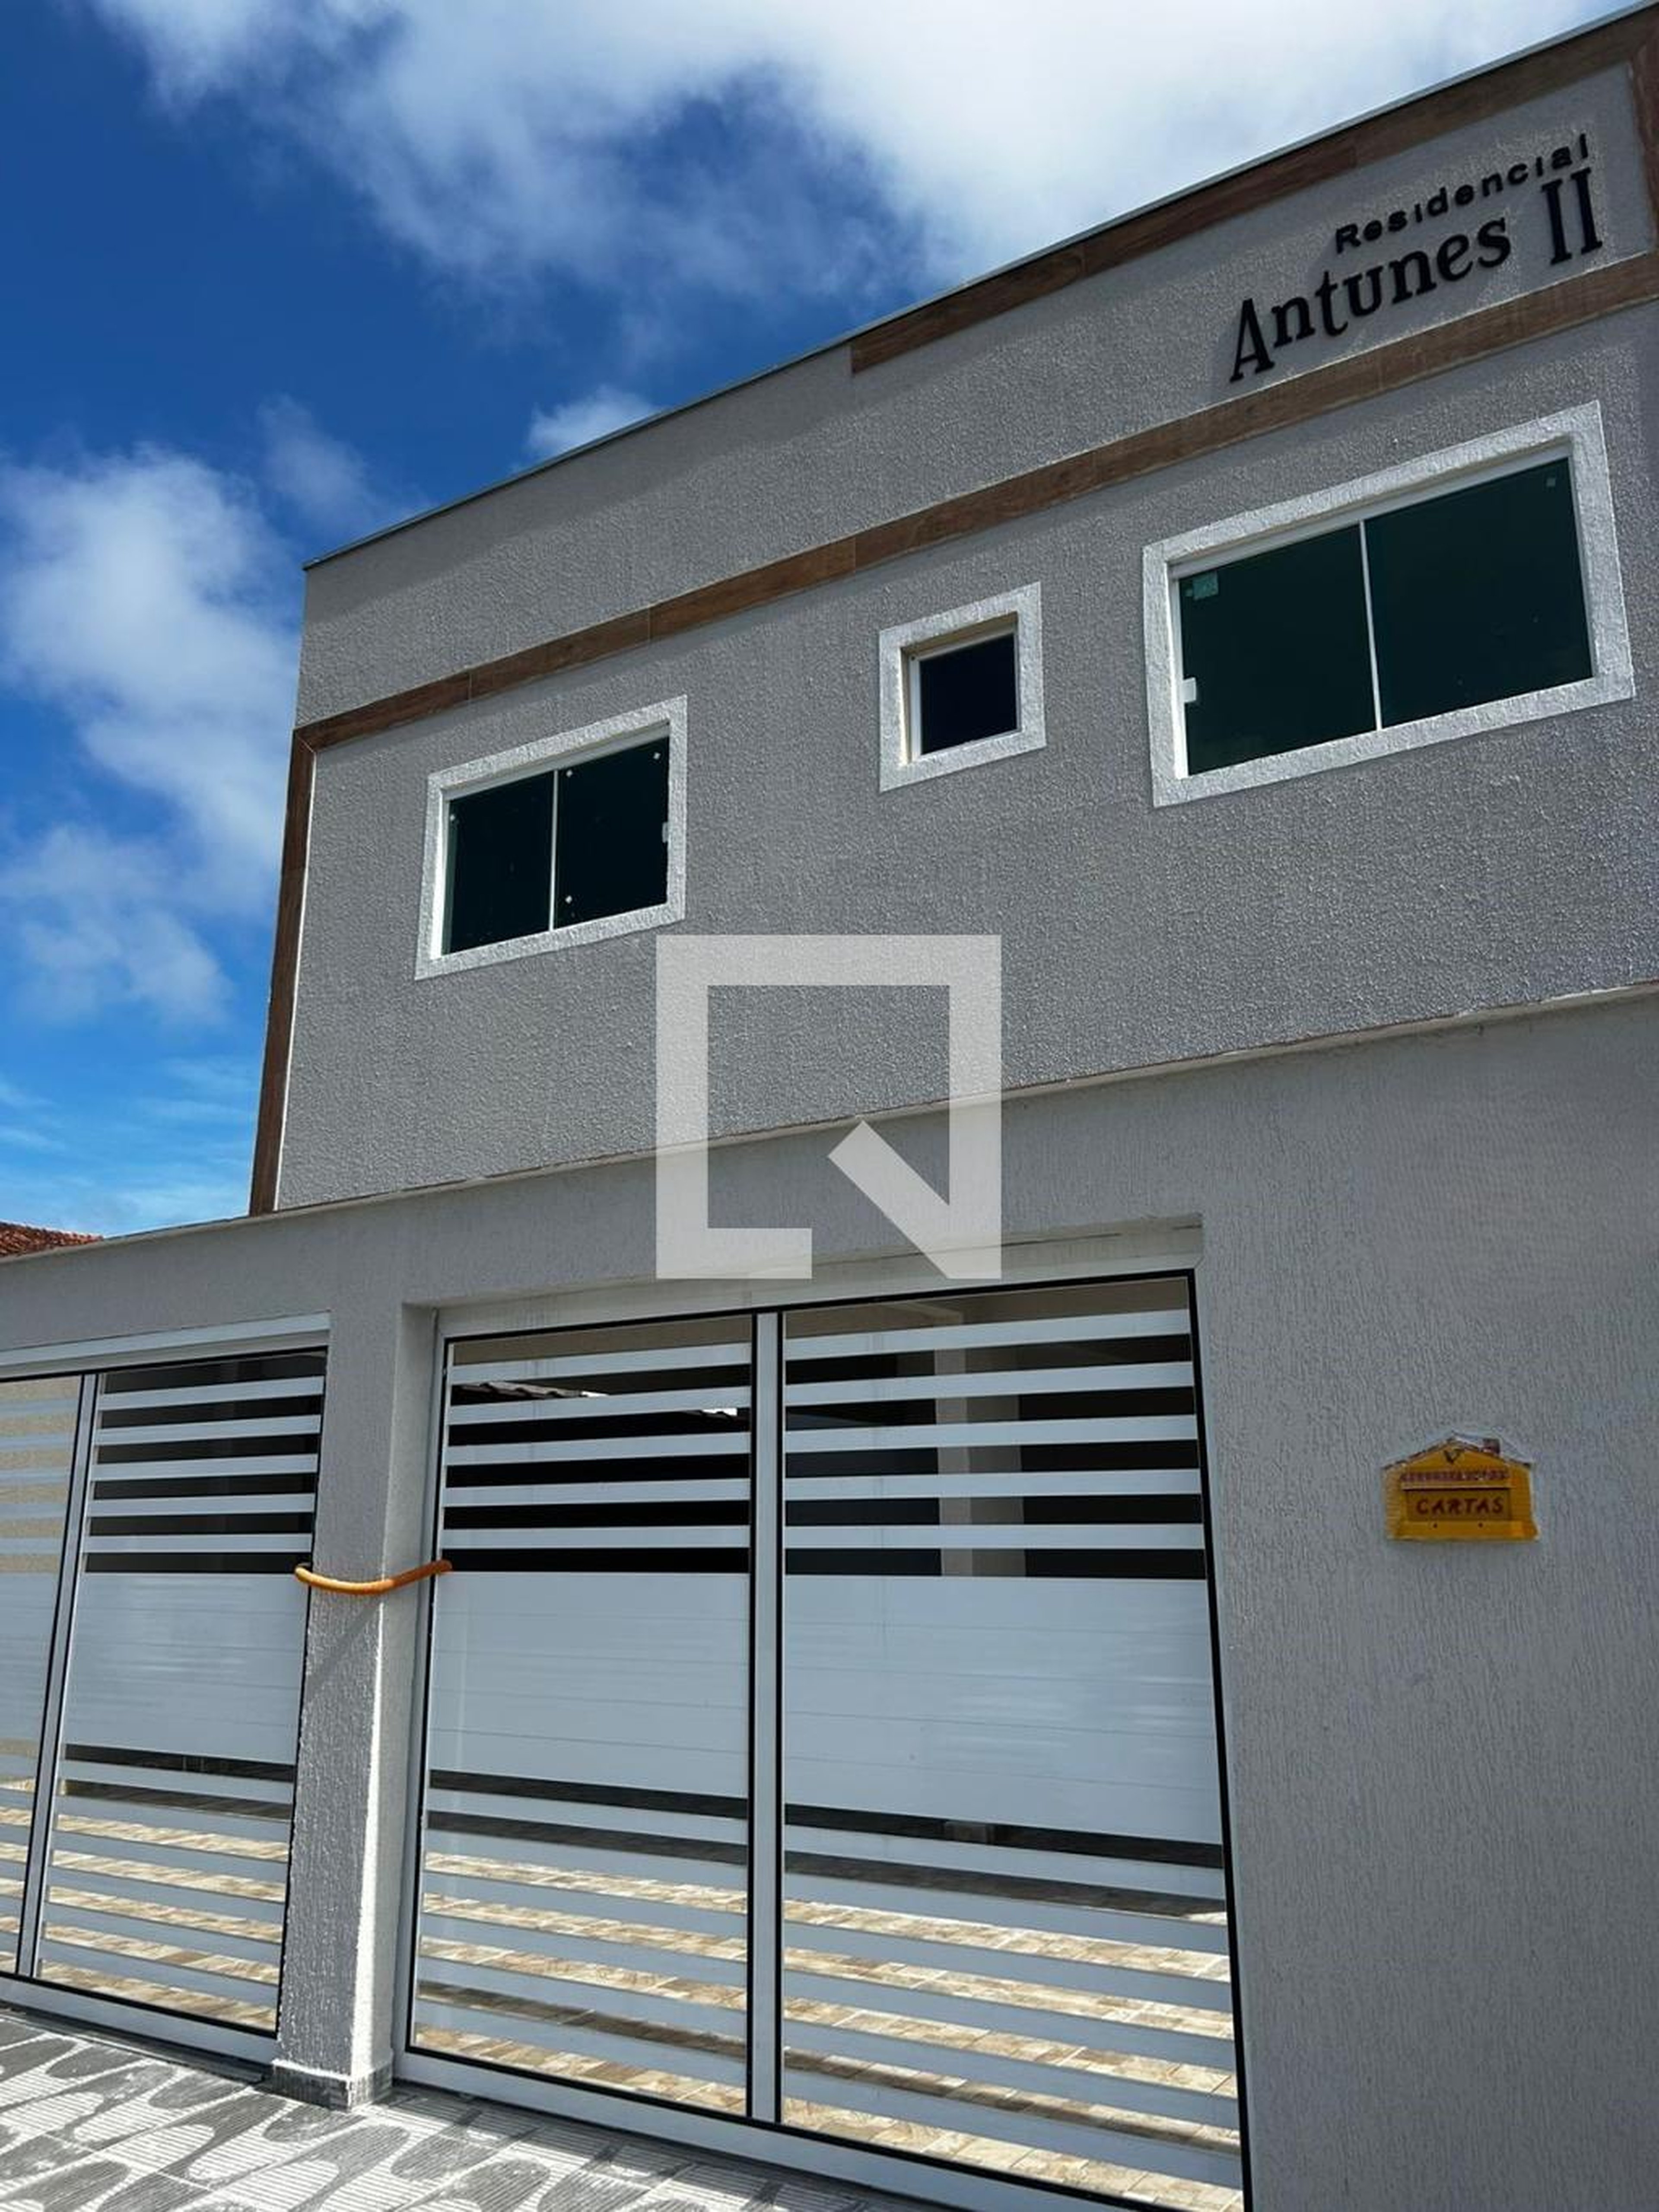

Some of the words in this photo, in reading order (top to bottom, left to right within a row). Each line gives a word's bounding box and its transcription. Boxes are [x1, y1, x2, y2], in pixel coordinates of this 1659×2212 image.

[1335, 134, 1589, 254] Residencial
[1230, 217, 1512, 382] Antunes
[1540, 167, 1603, 265] II
[1417, 1497, 1504, 1515] CARTAS
